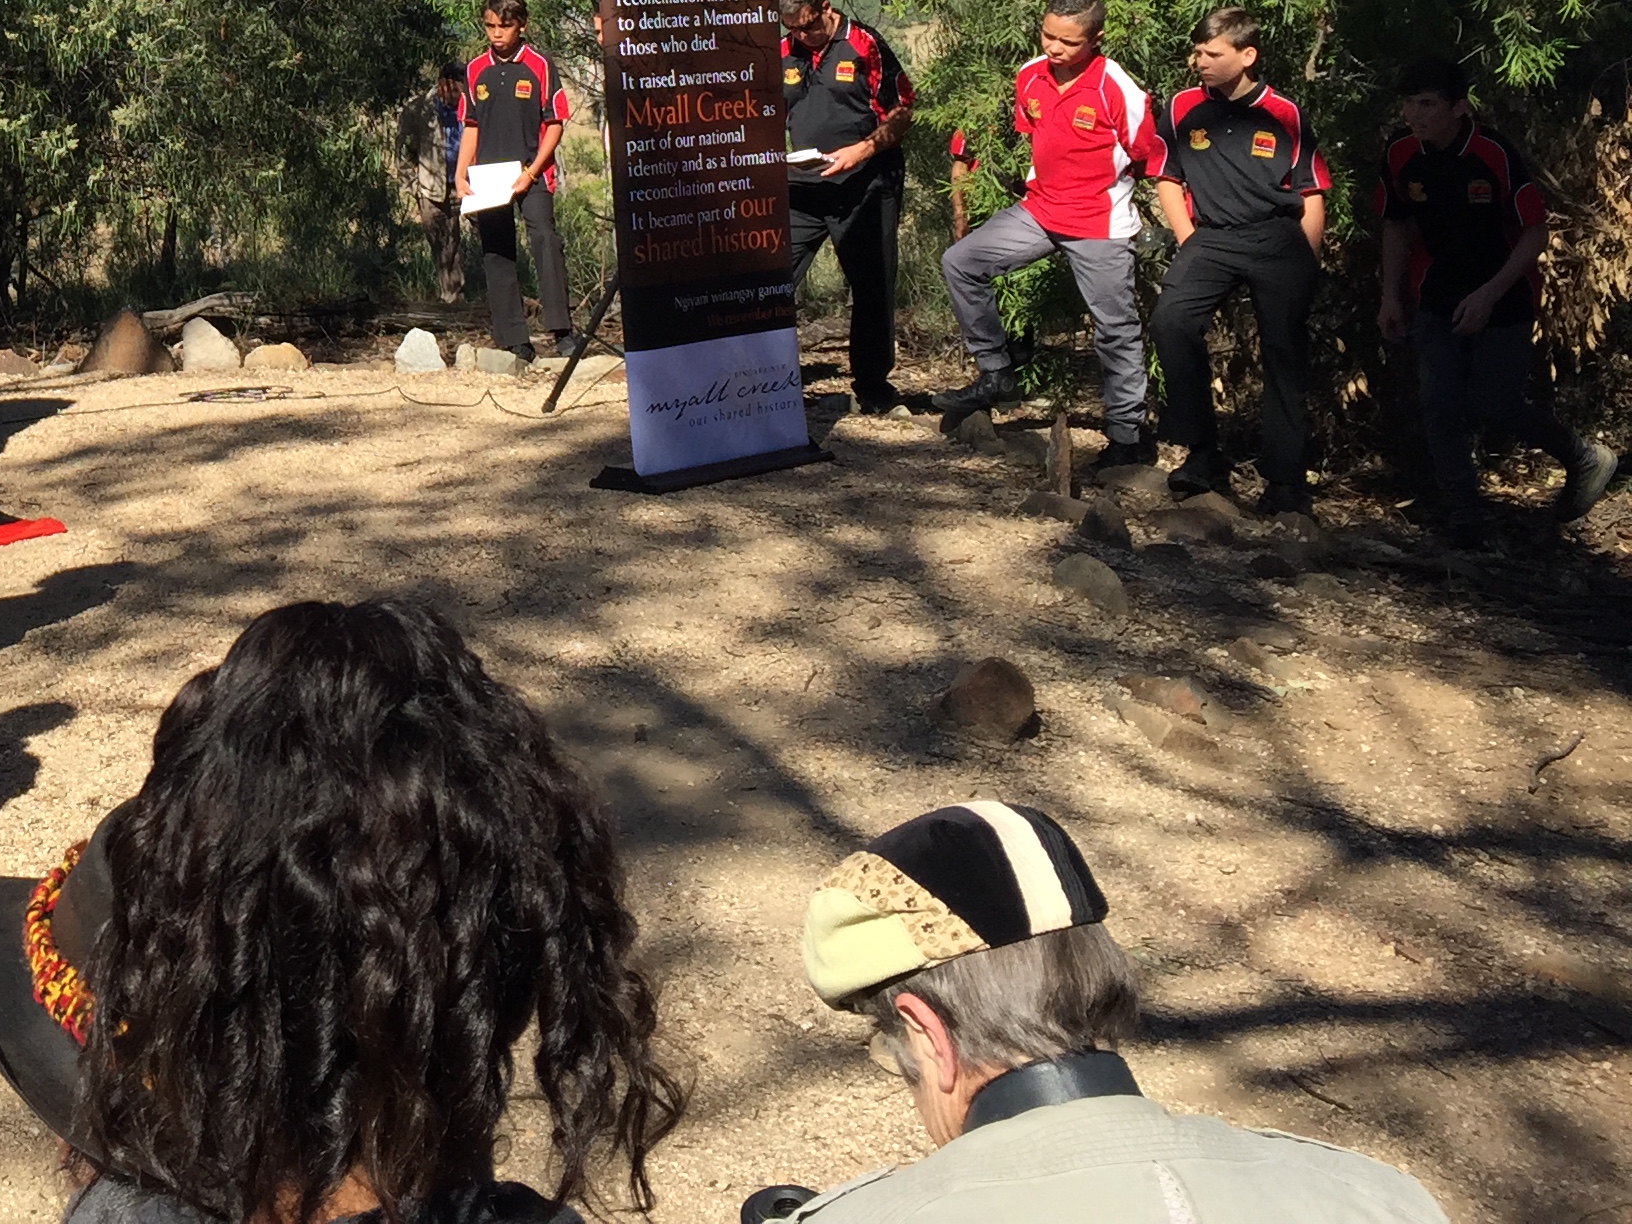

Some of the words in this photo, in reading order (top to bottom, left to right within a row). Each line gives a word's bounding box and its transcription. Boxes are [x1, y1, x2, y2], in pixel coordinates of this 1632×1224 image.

[618, 17, 634, 31] to
[639, 11, 689, 30] dedicate
[694, 15, 700, 26] a
[704, 6, 763, 26] Memorial
[767, 10, 778, 22] to
[619, 38, 657, 56] those
[661, 35, 687, 53] who
[691, 33, 719, 52] died.
[622, 72, 634, 90] It
[640, 69, 676, 89] raised
[679, 69, 736, 86] awareness
[740, 63, 754, 81] of
[625, 94, 690, 132] Myall
[697, 89, 758, 122] Creek
[763, 104, 775, 117] as
[626, 138, 655, 156] part
[660, 131, 672, 149] of
[675, 134, 694, 148] our
[699, 125, 745, 146] national
[628, 159, 678, 177] identity
[682, 153, 703, 172] and
[706, 157, 717, 170] as
[720, 157, 727, 168] a
[630, 180, 715, 201] reconciliation
[718, 177, 754, 192] event.
[632, 213, 644, 230] It
[649, 211, 693, 229] became
[697, 208, 720, 226] part
[724, 201, 736, 219] of
[741, 196, 776, 218] our
[635, 226, 703, 264] shared
[711, 226, 785, 253] history.
[712, 287, 755, 304] winangay
[646, 379, 729, 420] myall
[737, 371, 800, 398] creek
[689, 414, 707, 427] our
[713, 405, 752, 421] shared
[757, 399, 798, 415] history
